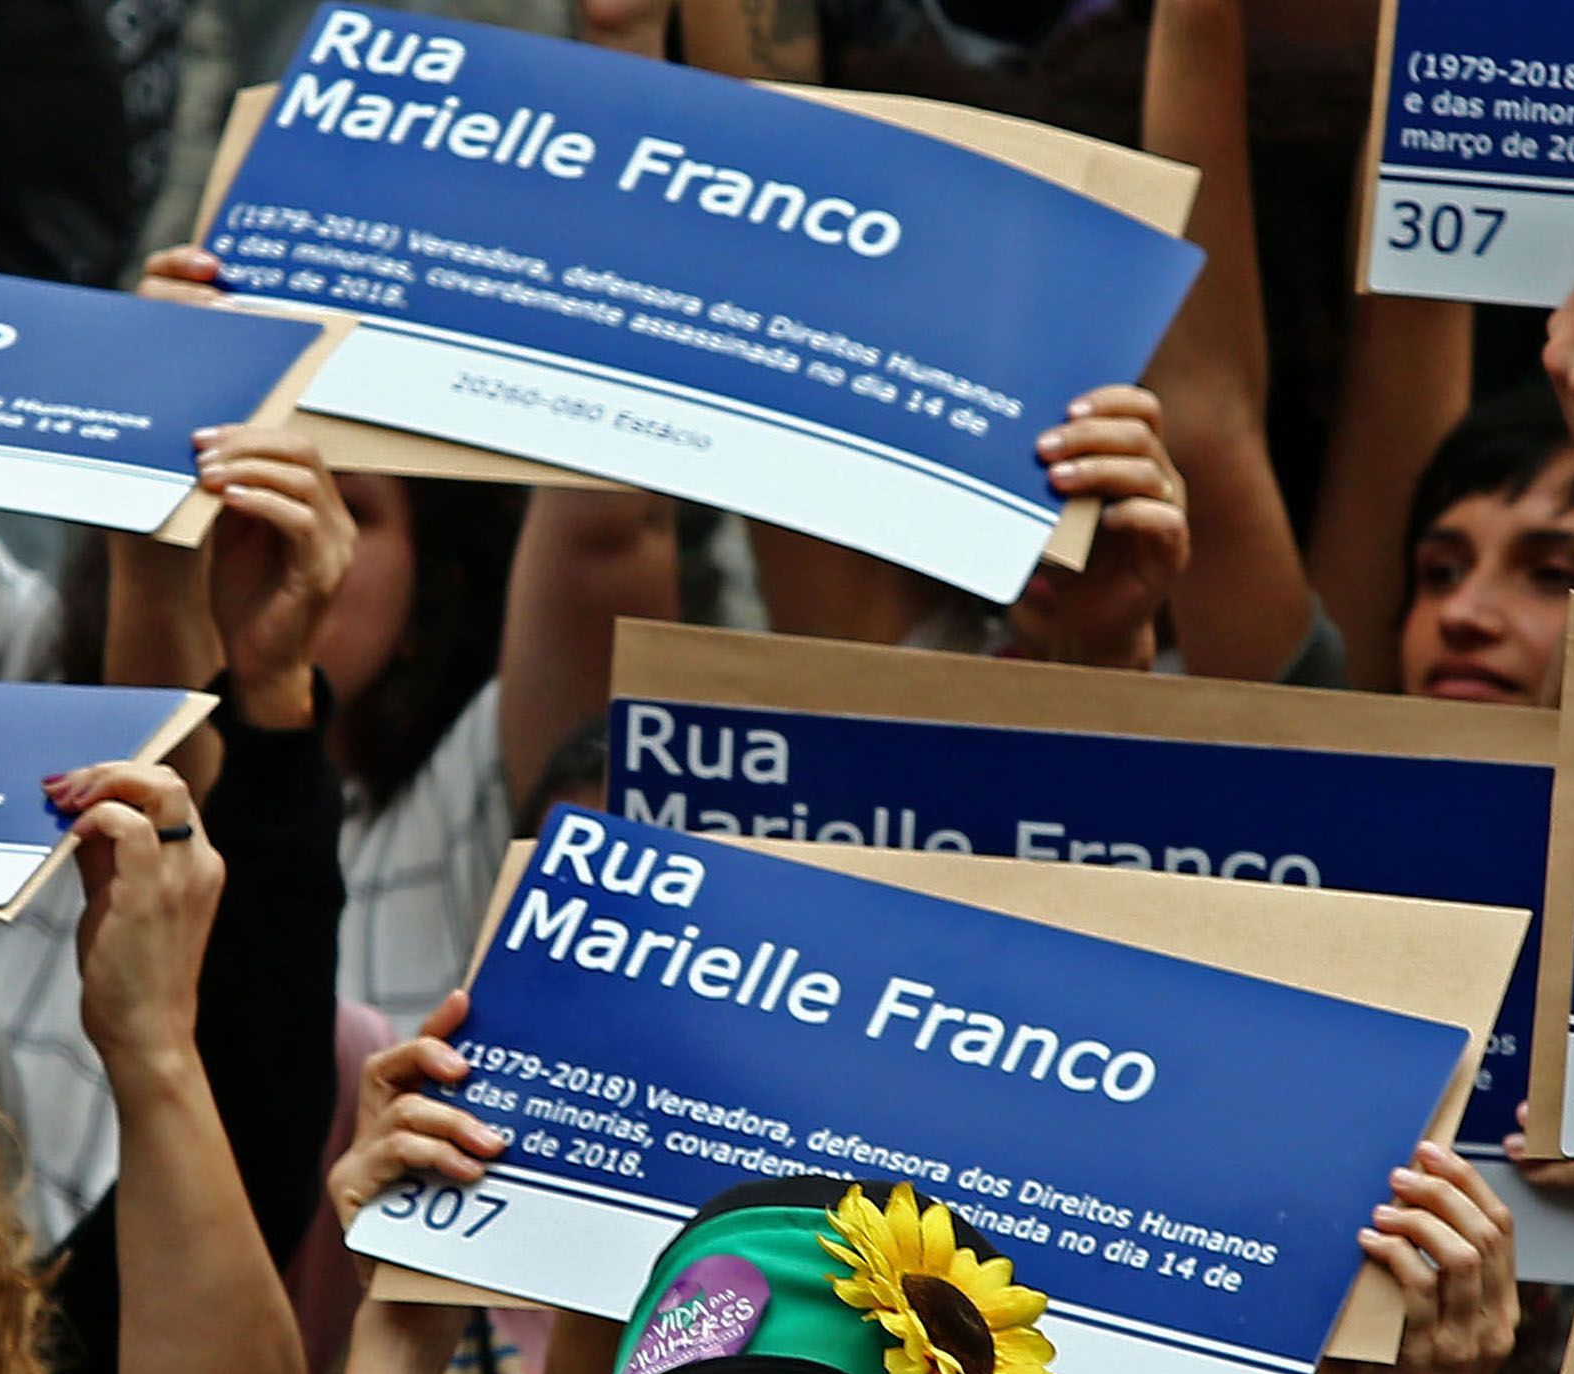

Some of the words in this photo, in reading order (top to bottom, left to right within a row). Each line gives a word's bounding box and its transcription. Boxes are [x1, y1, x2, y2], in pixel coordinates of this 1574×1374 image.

[310, 11, 463, 83] Rua
[1404, 92, 1423, 113] e
[1431, 89, 1484, 118] das
[276, 71, 594, 177] Marielle
[618, 138, 902, 255] Franco
[1401, 128, 1492, 159] março
[1501, 130, 1538, 158] de
[1388, 199, 1507, 256] 307
[624, 703, 790, 786] Rua
[541, 814, 704, 908] Rua
[503, 887, 840, 1023] Marielle
[865, 976, 1155, 1101] Franco
[380, 1171, 507, 1236] 307
[648, 1085, 796, 1149] Vereadora,
[808, 1128, 950, 1183] defensora
[958, 1166, 1012, 1198] dos
[1018, 1179, 1133, 1228] Direitos
[1139, 1210, 1278, 1265] Humanos
